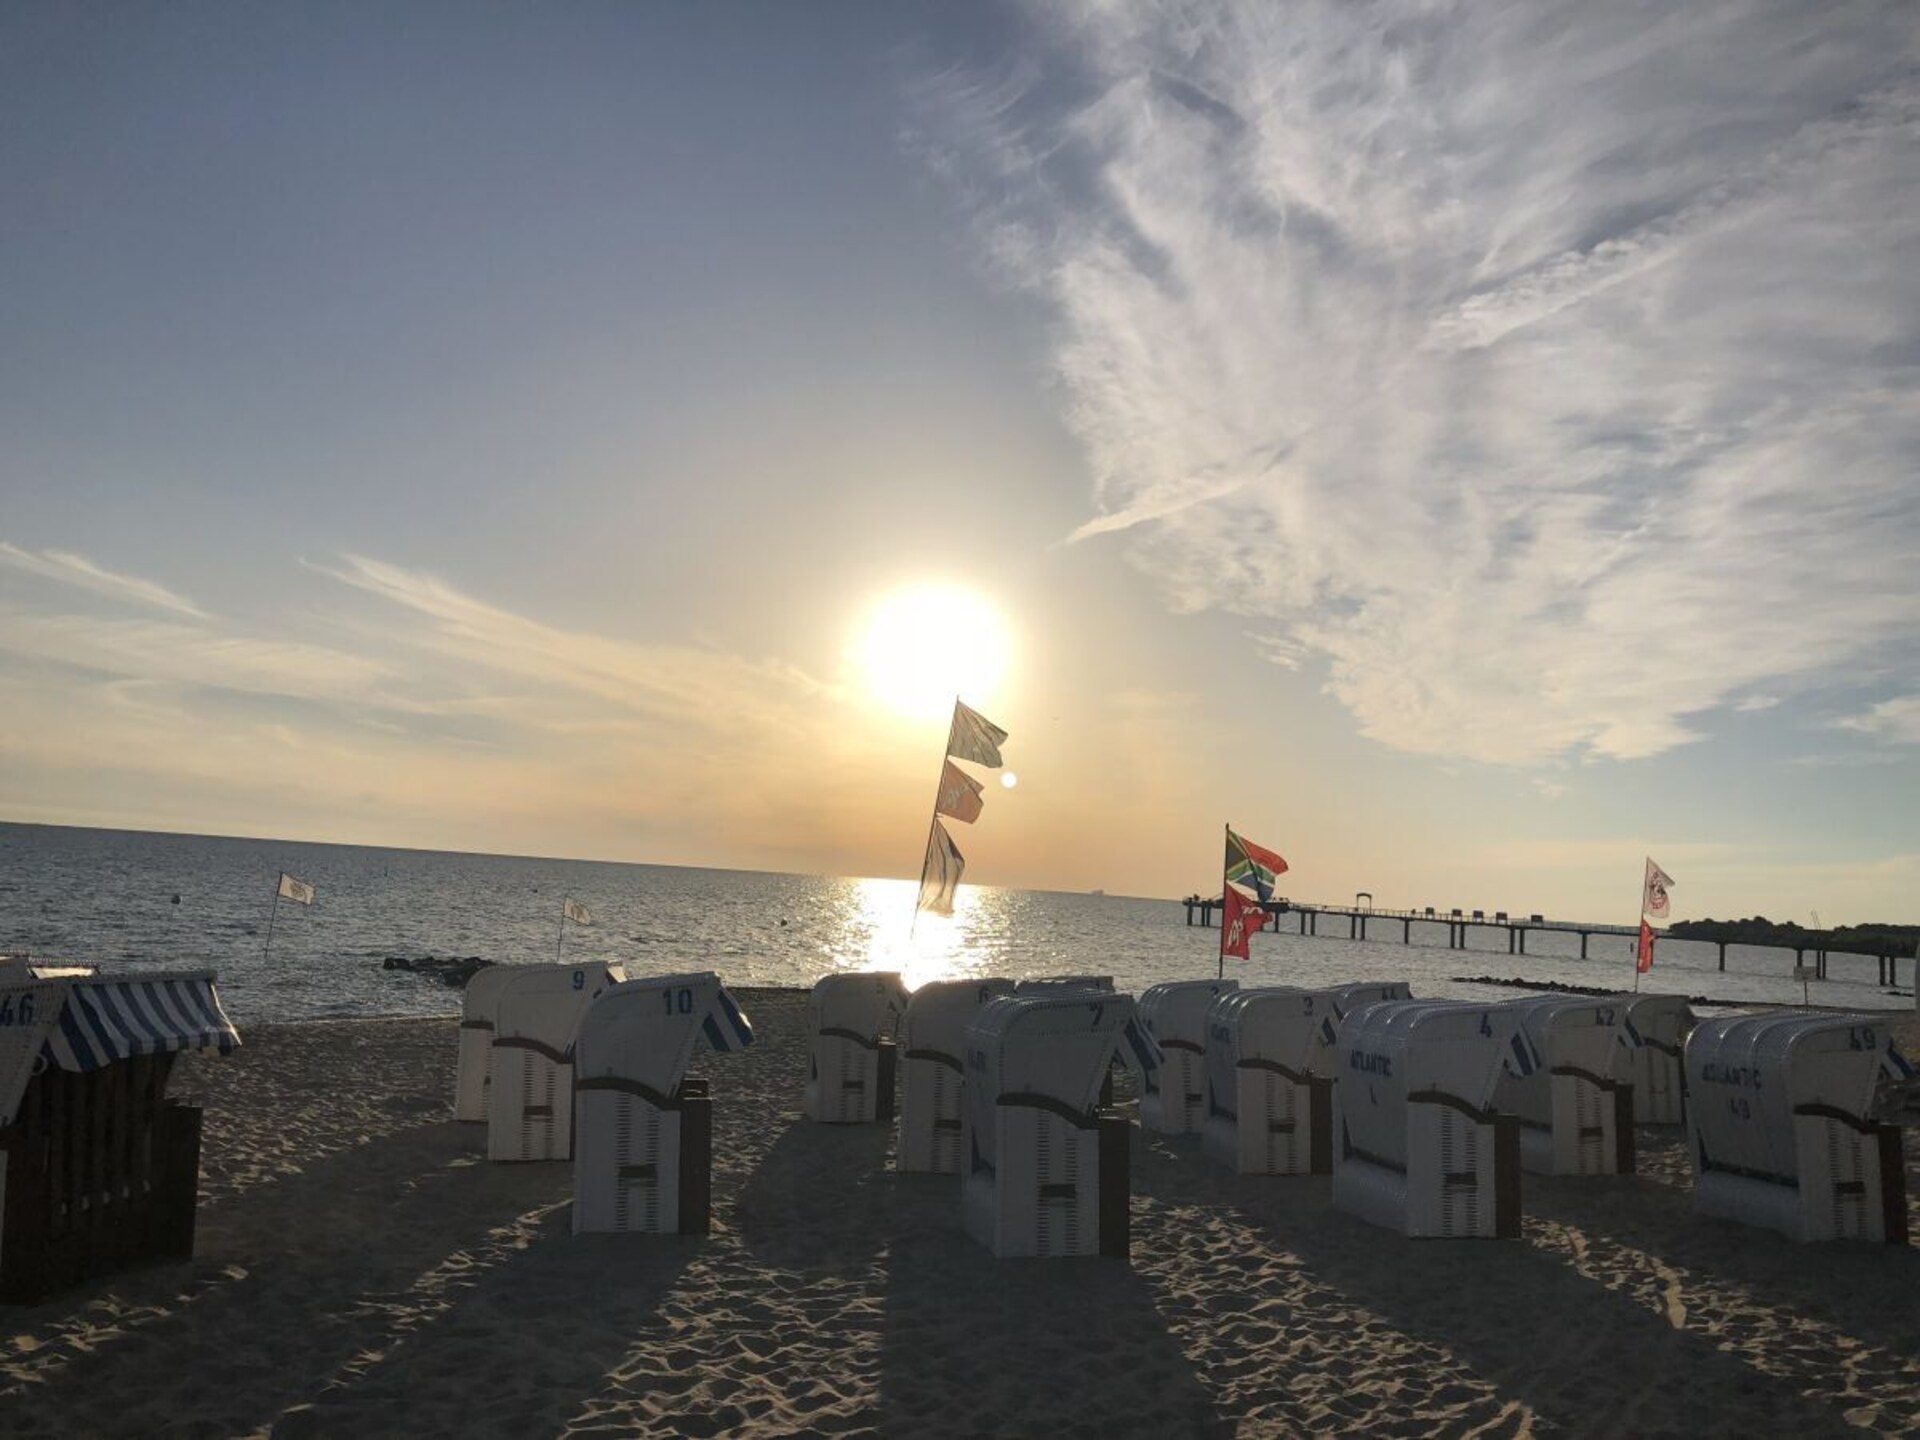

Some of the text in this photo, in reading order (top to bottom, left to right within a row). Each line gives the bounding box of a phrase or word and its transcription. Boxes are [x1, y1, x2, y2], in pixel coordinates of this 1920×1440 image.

[572, 970, 585, 990] 9
[663, 989, 692, 1015] 10
[1089, 1001, 1104, 1026] 7
[1303, 996, 1314, 1017] 3
[1479, 1013, 1493, 1039] 4
[1596, 1008, 1616, 1027] 42
[1850, 1027, 1877, 1052] 49
[1349, 1049, 1393, 1078] ATLANTIC
[1702, 1062, 1762, 1091] ATLANTIC
